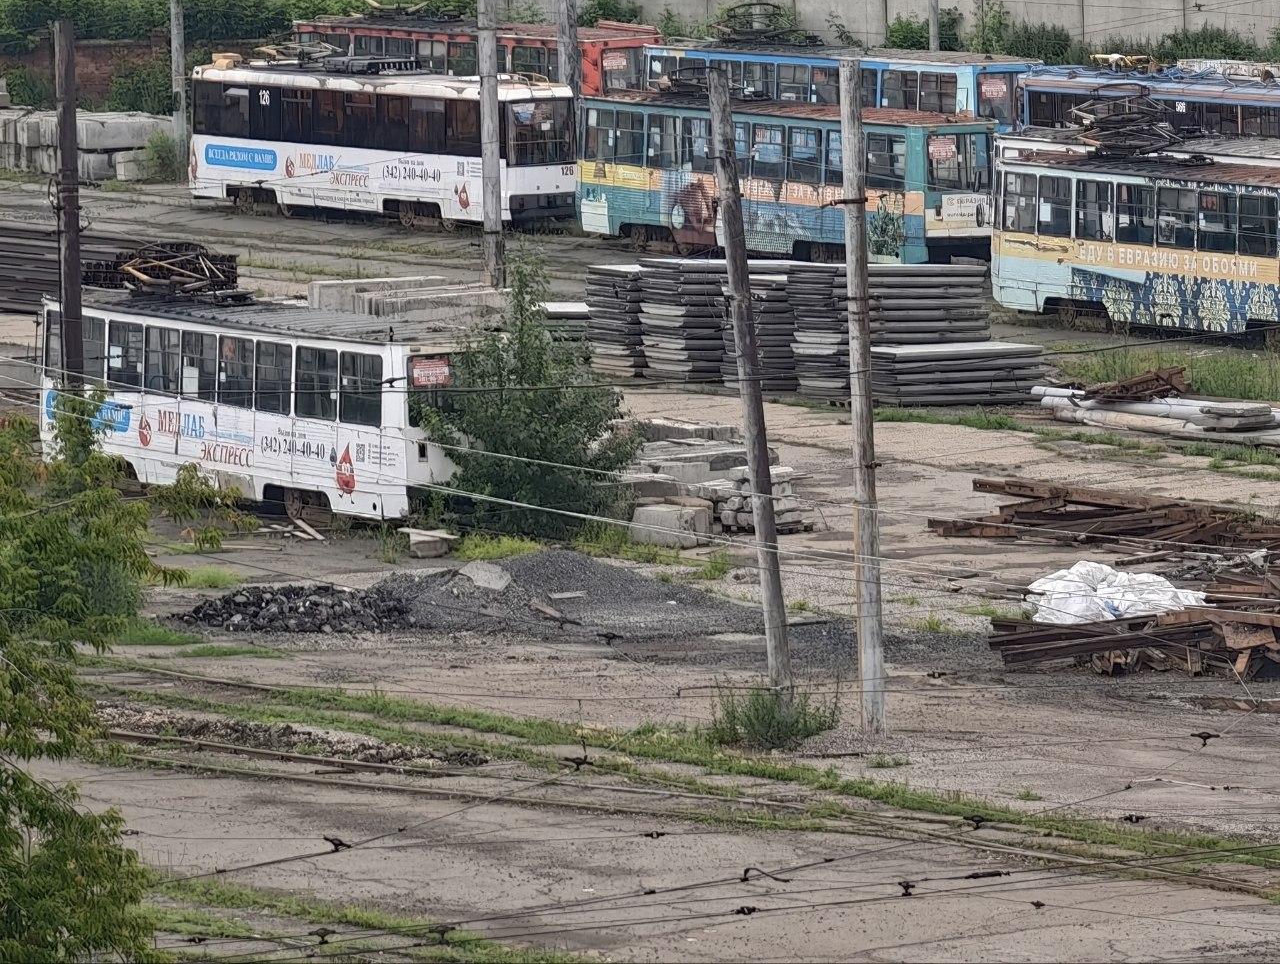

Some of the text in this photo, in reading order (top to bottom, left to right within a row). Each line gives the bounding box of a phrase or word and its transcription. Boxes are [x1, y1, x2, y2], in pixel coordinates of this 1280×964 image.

[259, 89, 270, 106] 126
[300, 151, 334, 172] МЕДЛАБ
[560, 165, 575, 177] 126
[329, 171, 369, 188] ЭКСПРЕСС
[382, 165, 401, 183] (342)
[402, 166, 441, 184] 240-40-40
[1079, 244, 1257, 277] ЕДУ В ЕВРАЗИЮ ЗА ОБОЯМИ
[157, 409, 205, 439] МЕДЛАБ
[200, 441, 254, 469] ЭКСПРЕСС
[261, 435, 281, 458] (342)
[282, 438, 326, 460] 240-40-40
